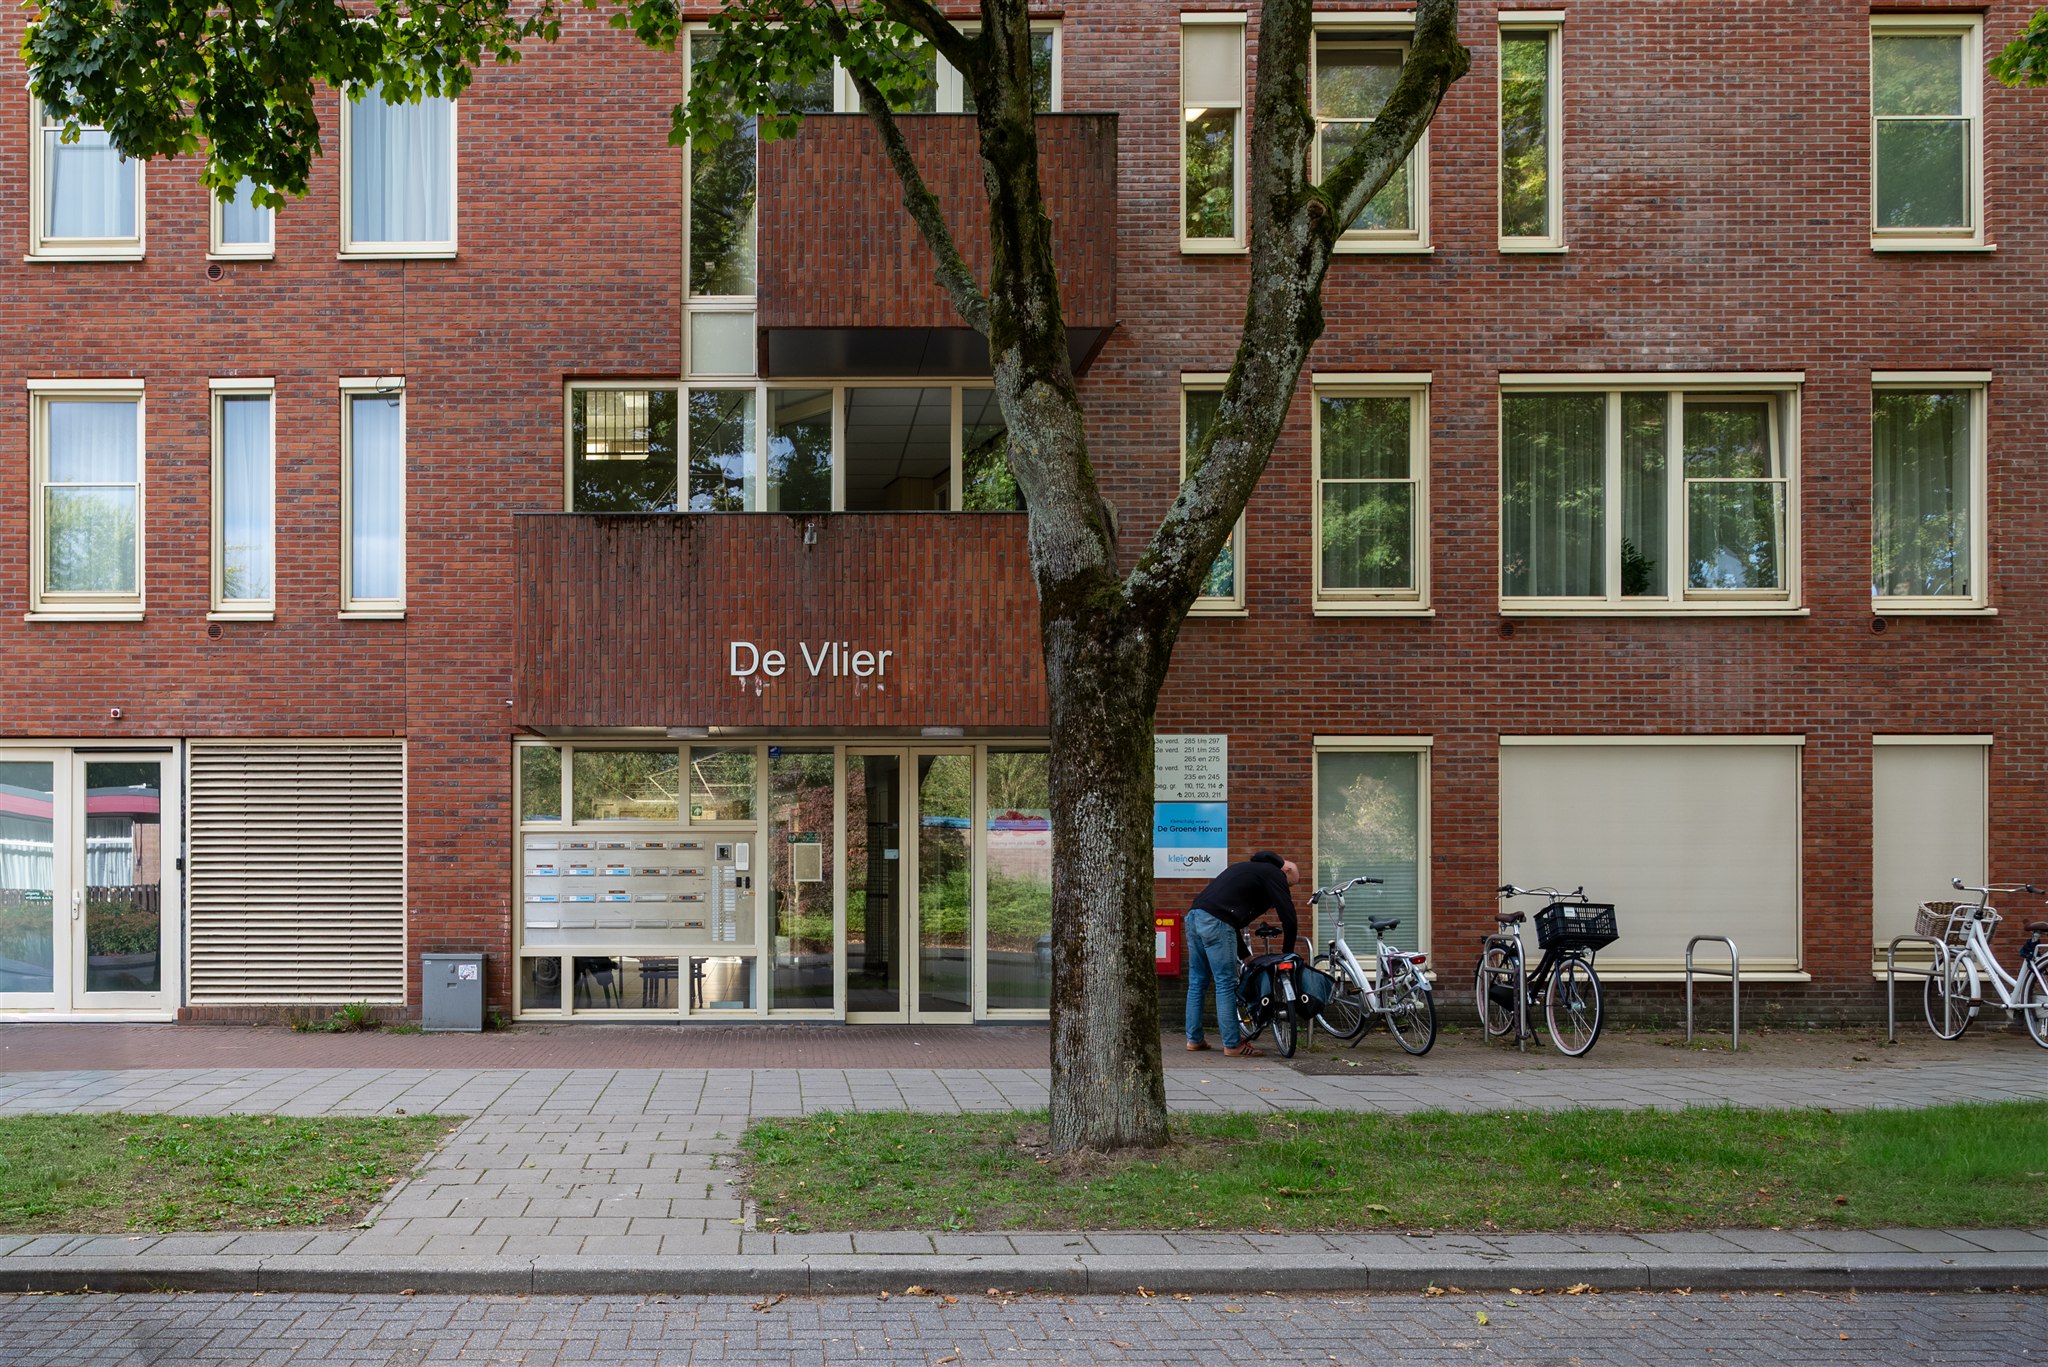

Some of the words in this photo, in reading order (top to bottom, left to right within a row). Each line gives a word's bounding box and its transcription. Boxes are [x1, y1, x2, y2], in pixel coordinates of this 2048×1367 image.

[730, 641, 786, 677] De
[799, 641, 893, 677] Vlier
[1157, 825, 1168, 833] De
[1169, 825, 1197, 833] Groene
[1198, 825, 1223, 833] Hoven
[1168, 854, 1211, 866] kleingeluk
